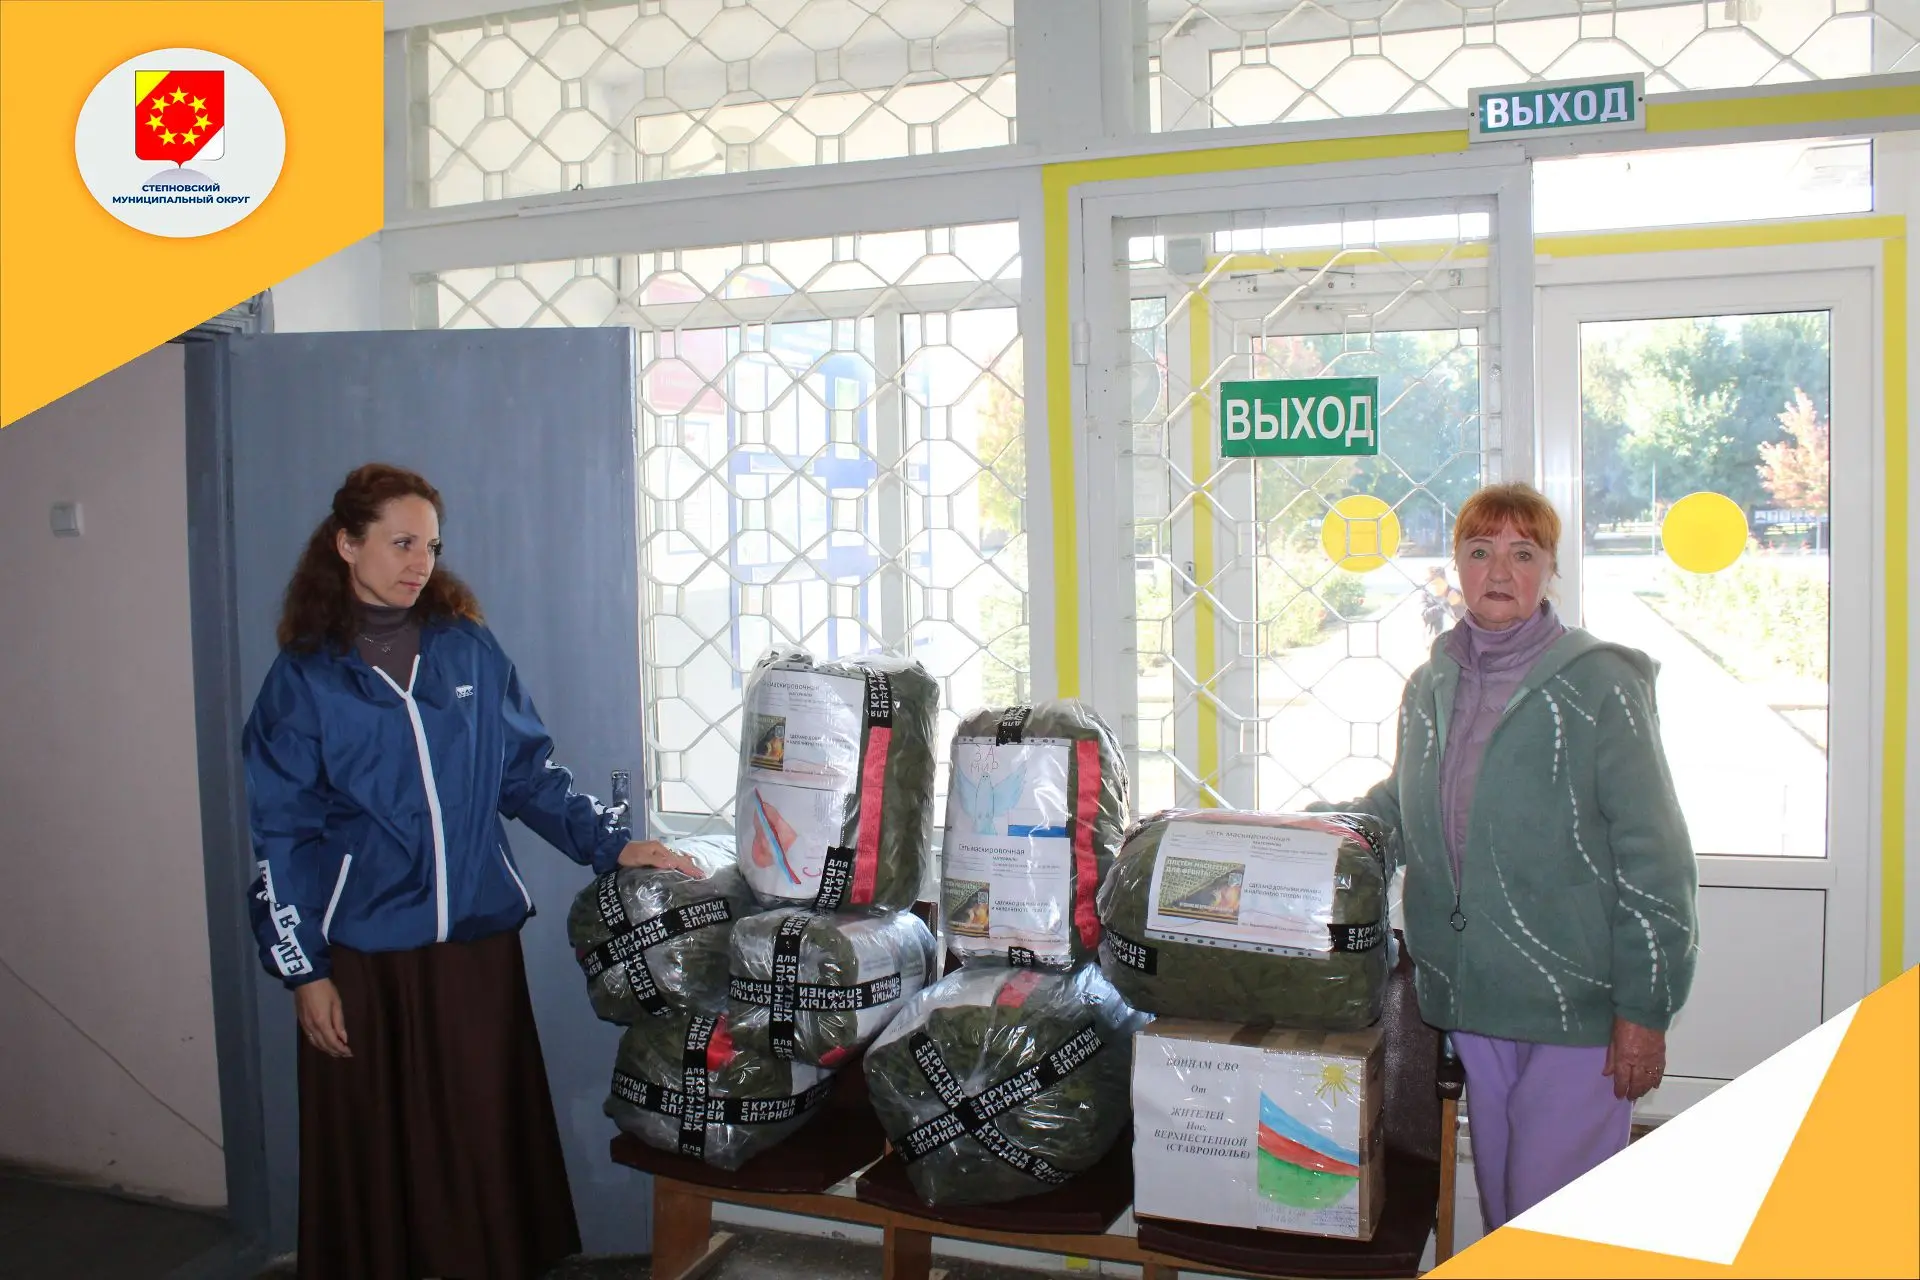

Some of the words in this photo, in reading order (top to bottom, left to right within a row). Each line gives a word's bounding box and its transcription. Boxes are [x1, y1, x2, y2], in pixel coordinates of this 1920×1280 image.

[1486, 86, 1628, 128] ВЫХОД
[1226, 395, 1374, 447] ВЫХОД
[828, 858, 849, 869] ДЛЯ
[687, 900, 725, 916] КРУТЫХ
[614, 917, 665, 949] КРУТЫХ
[1347, 928, 1356, 950] ДЛЯ
[776, 954, 797, 963] ДЛЯ
[1138, 947, 1146, 969] ДЛЯ
[783, 965, 796, 1022] КРУТЫХ
[799, 998, 855, 1009] КРУТЫХ
[773, 1038, 793, 1047] ДЛЯ
[1049, 1054, 1066, 1075] ДЛЯ
[1058, 1027, 1096, 1060] КРУТЫХ
[686, 1066, 705, 1075] ДЛЯ
[915, 1040, 932, 1059] ДЛЯ
[927, 1050, 966, 1102] КРУТЫХ
[1217, 1061, 1239, 1072] СВО
[979, 1069, 1036, 1107] КРУТЫХ
[1191, 1084, 1206, 1094] От
[660, 1090, 669, 1112] ДЛЯ
[693, 1077, 705, 1132] КРУТЫХ
[740, 1101, 749, 1122] ДЛЯ
[751, 1099, 796, 1111] КРУТЫХ
[912, 1112, 959, 1143] КРУТЫХ
[1154, 1128, 1249, 1148] ВЕРХНЕСТЕПНОЙ
[1166, 1142, 1251, 1159] (СТАВРОПОЛЬЕ)
